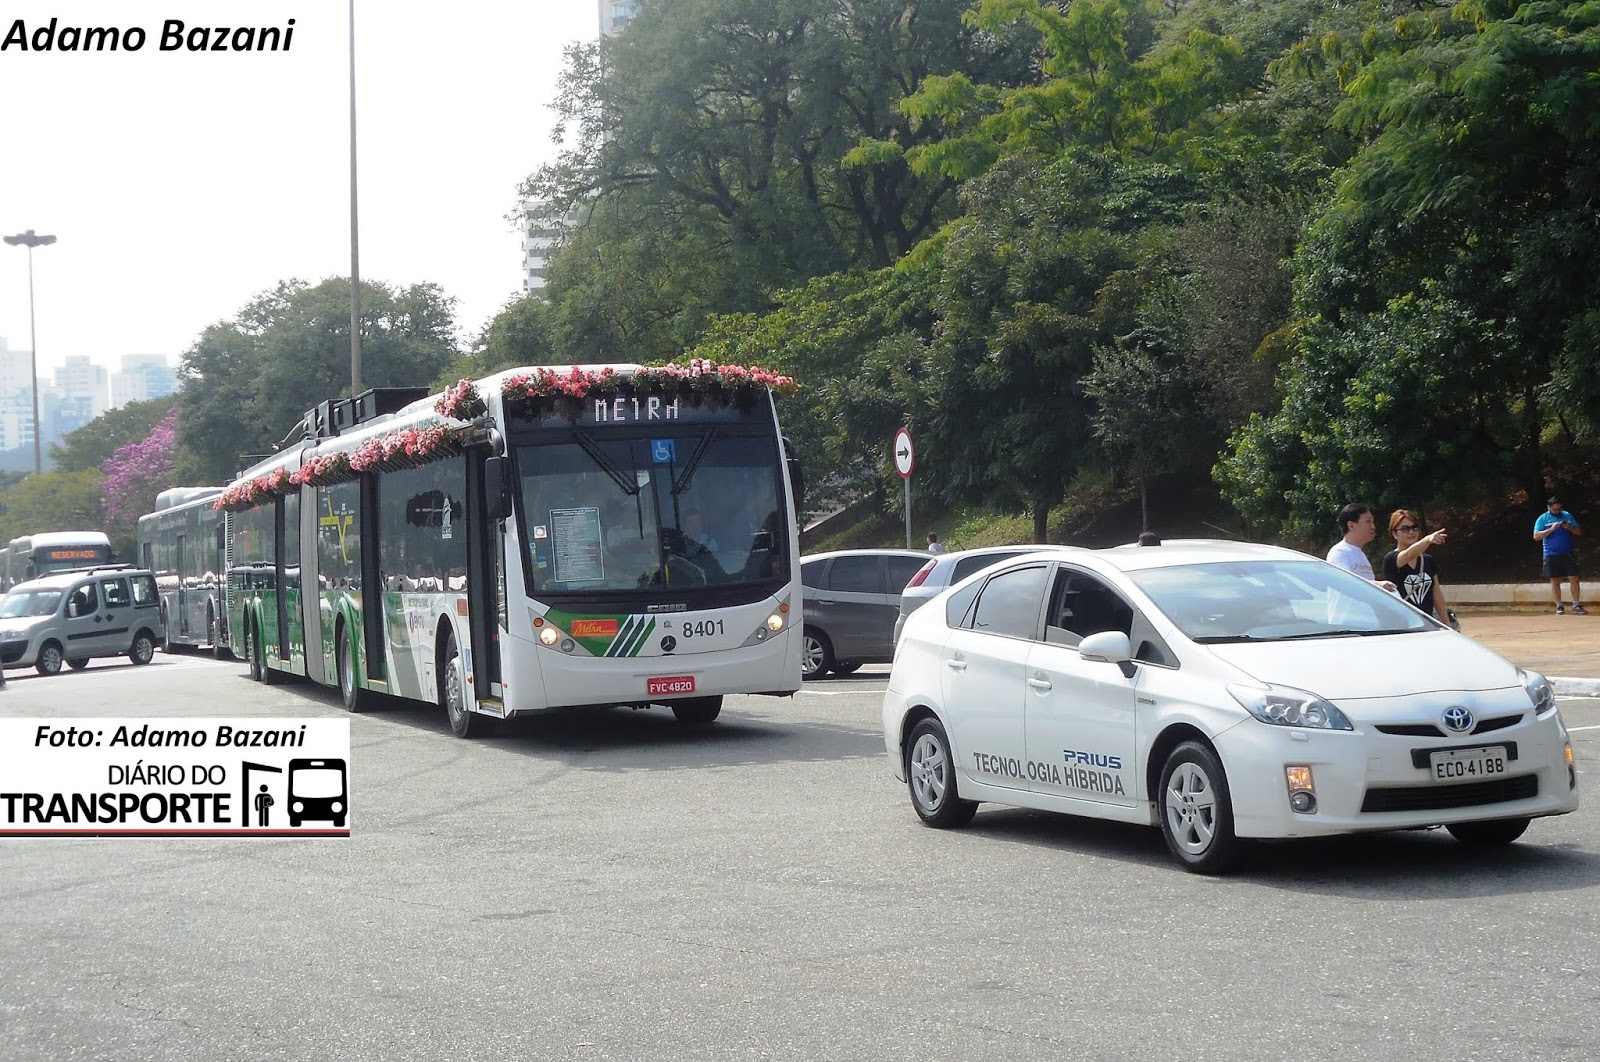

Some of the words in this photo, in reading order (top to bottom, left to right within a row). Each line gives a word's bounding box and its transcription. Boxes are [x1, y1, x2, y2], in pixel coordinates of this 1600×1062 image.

[682, 619, 725, 639] 8401
[1063, 750, 1122, 769] PRIUS
[973, 752, 1062, 785] TECNOLOGIA
[1064, 763, 1125, 796] HÍBRIDA
